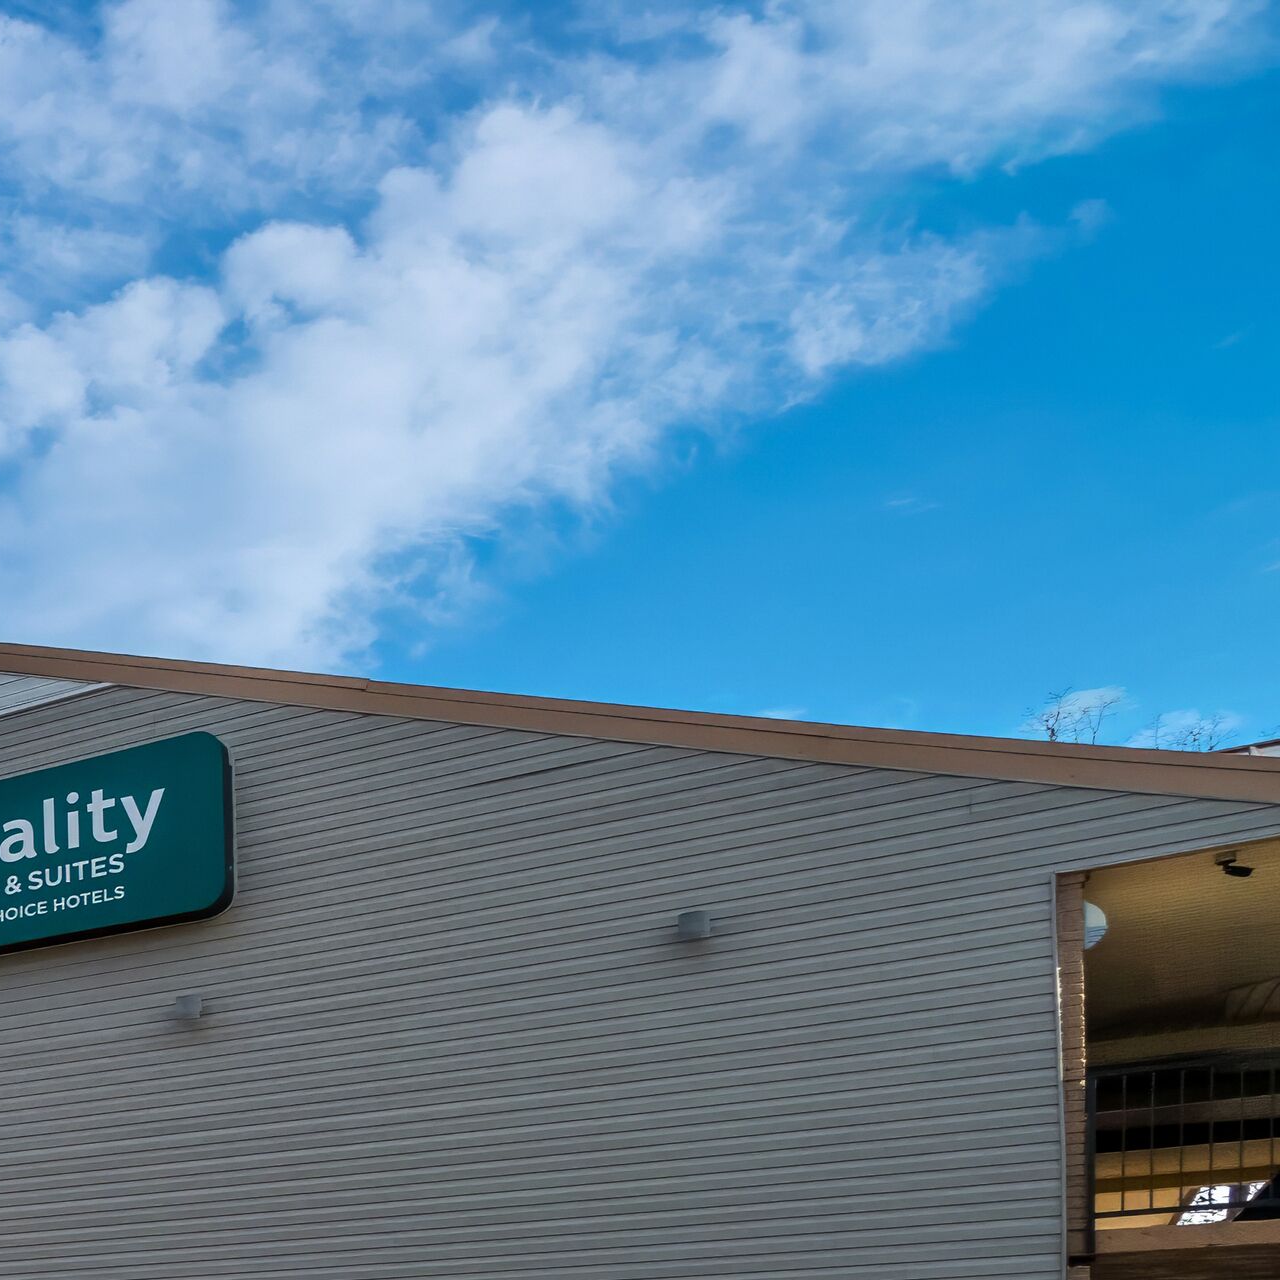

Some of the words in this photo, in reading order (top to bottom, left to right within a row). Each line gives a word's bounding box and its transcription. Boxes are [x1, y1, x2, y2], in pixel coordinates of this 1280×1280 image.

[4, 875, 22, 895] &
[27, 853, 125, 891] SUITES
[53, 886, 125, 912] HOTELS
